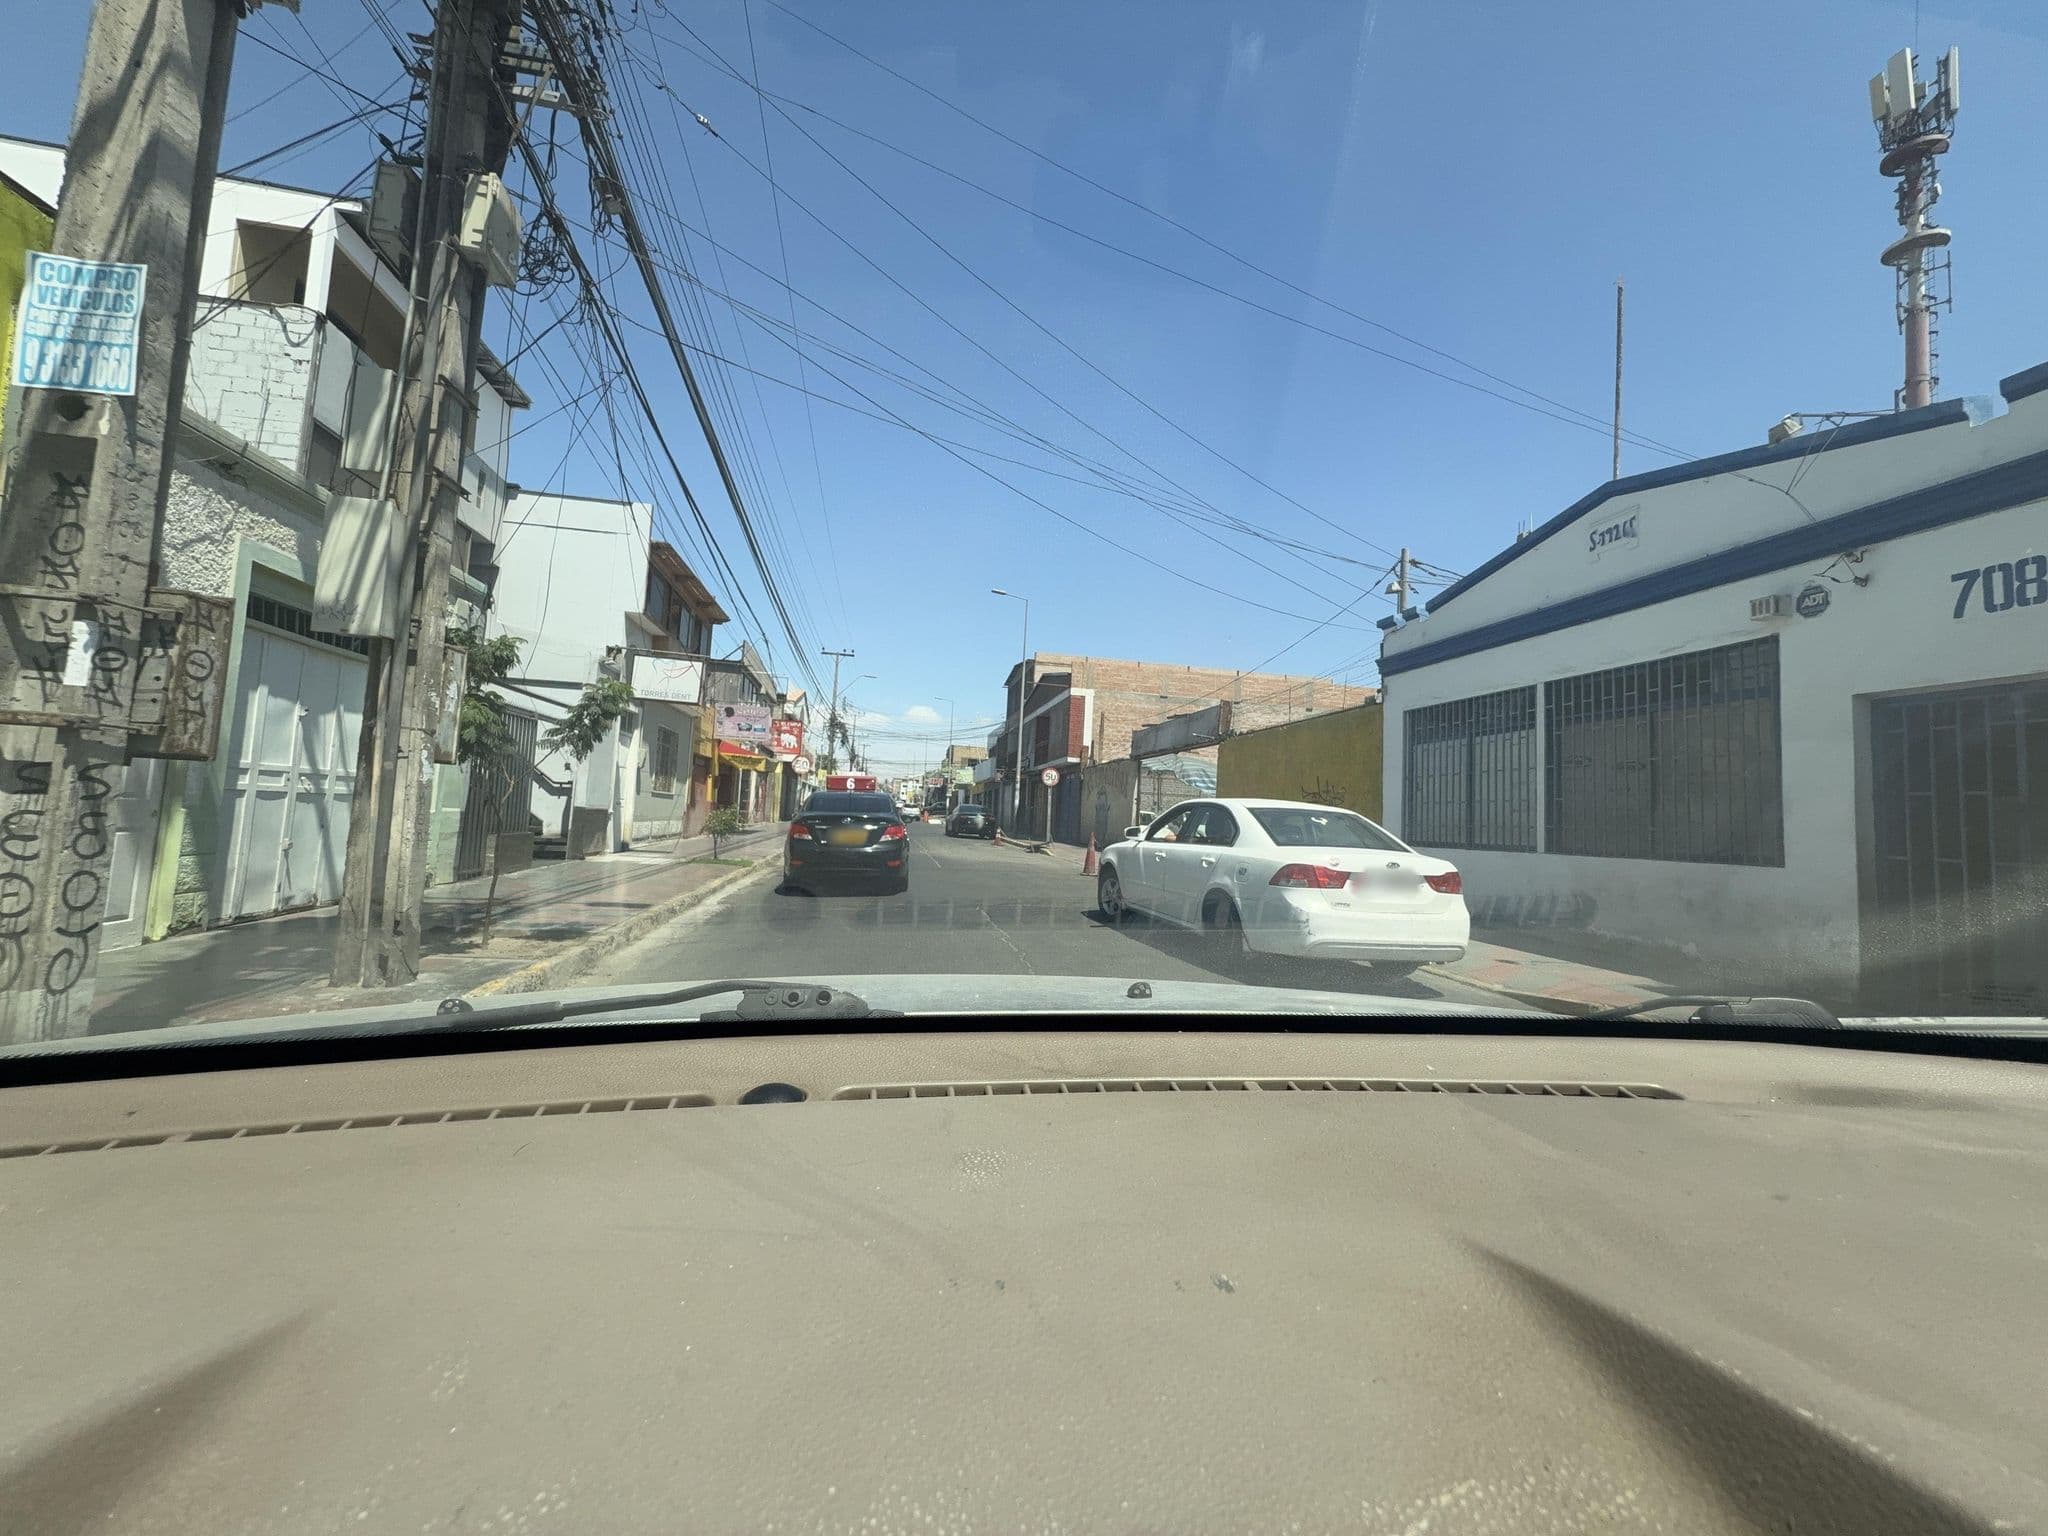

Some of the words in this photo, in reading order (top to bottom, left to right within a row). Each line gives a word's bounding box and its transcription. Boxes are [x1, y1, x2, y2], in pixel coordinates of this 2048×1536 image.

[39, 261, 137, 291] COMPRO
[37, 285, 136, 314] VEHICULOS
[1801, 592, 1825, 609] ADT
[1951, 554, 2048, 619] 708
[846, 777, 856, 790] 6
